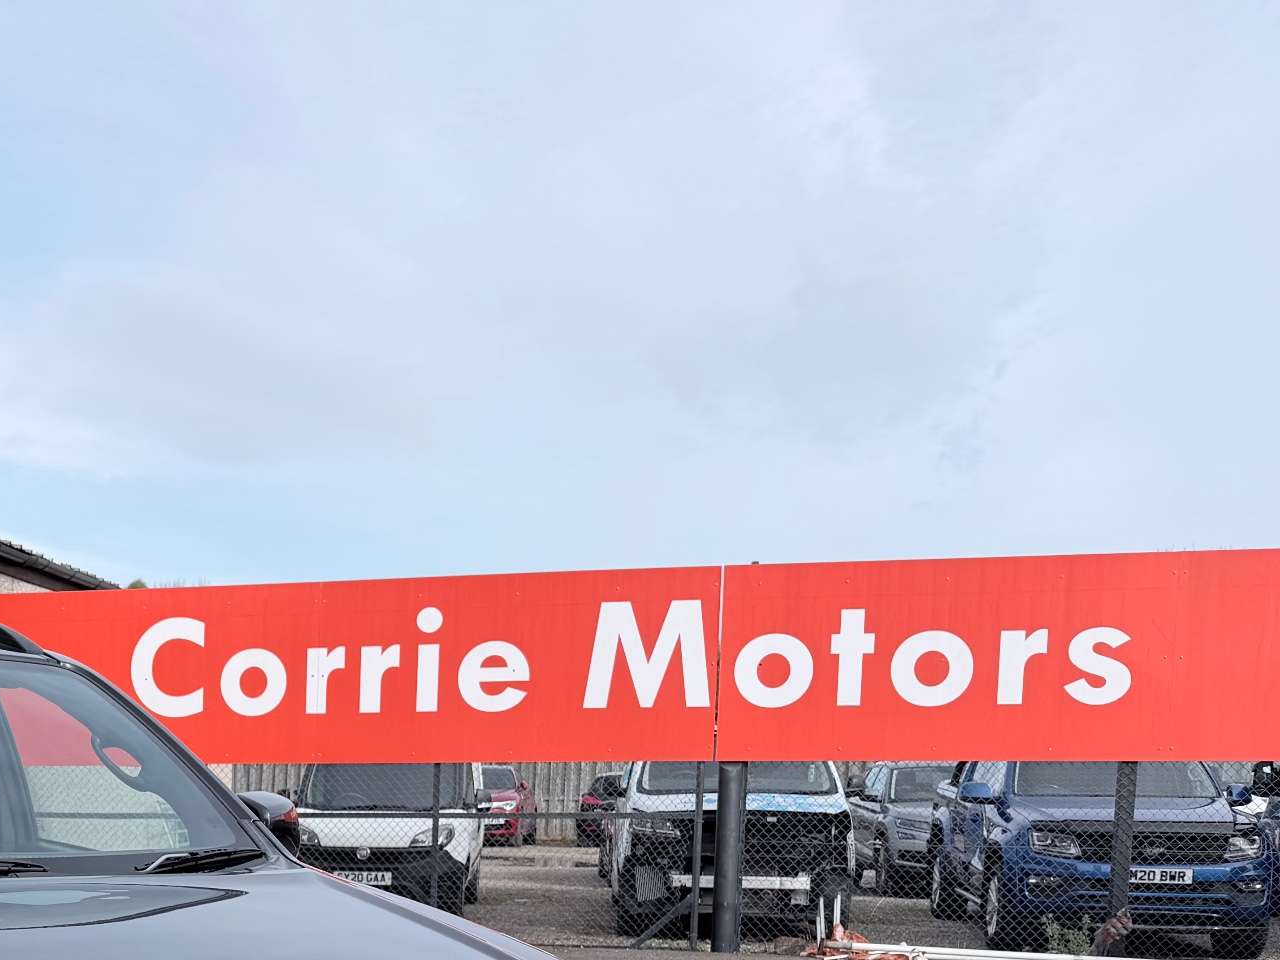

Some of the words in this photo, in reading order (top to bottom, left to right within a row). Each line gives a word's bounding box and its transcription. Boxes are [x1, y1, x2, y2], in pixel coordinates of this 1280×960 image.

[130, 606, 531, 718] Corrie
[583, 599, 1132, 709] Motors
[1129, 869, 1156, 881] M20
[1160, 870, 1187, 882] BWR
